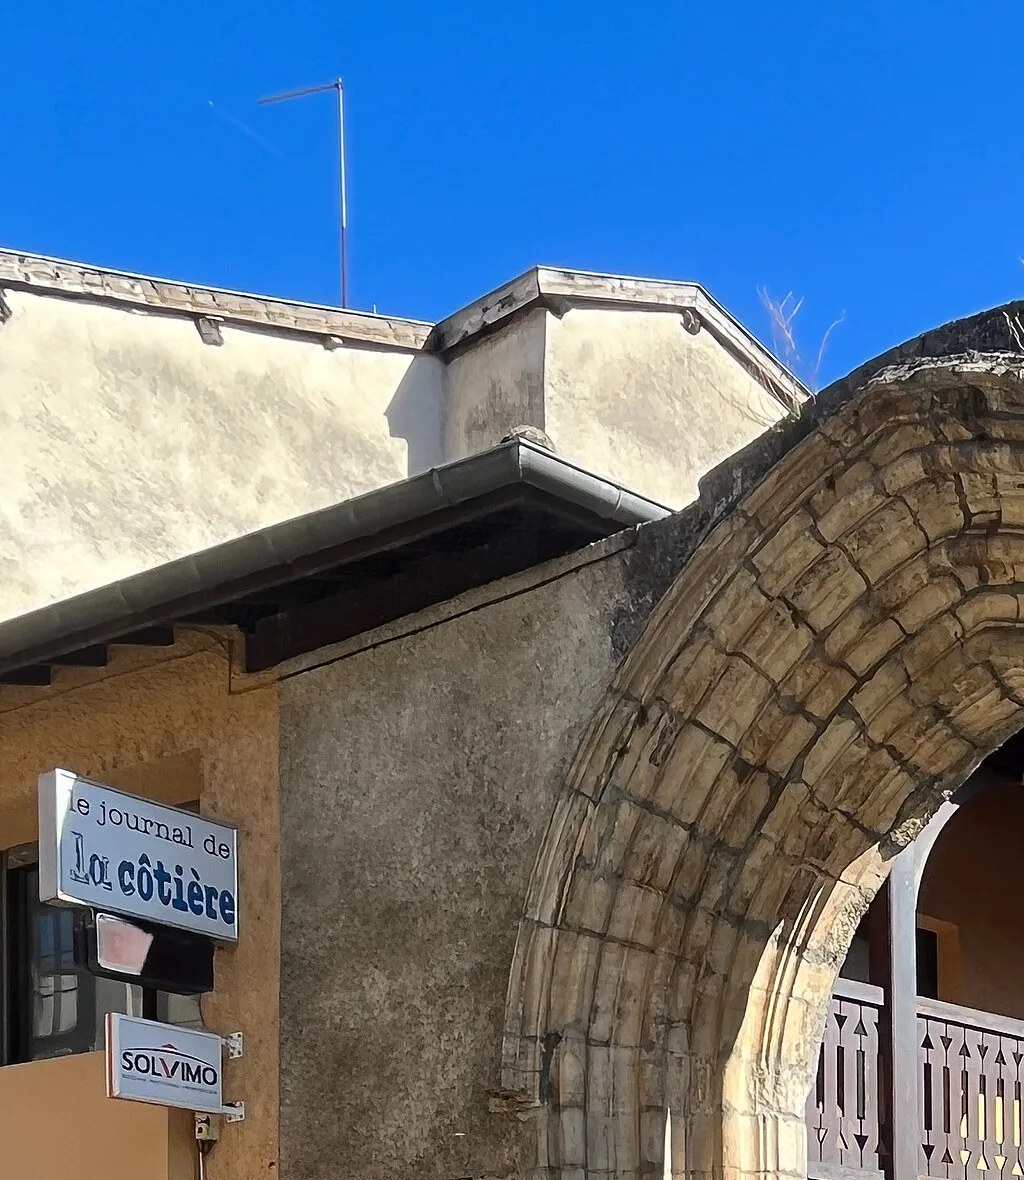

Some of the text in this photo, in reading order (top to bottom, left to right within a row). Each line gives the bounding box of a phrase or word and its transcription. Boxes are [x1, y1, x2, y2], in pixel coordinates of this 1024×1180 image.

[68, 788, 231, 859] le journal de
[69, 830, 236, 925] la côtière
[121, 1051, 218, 1086] SOLVIMO
